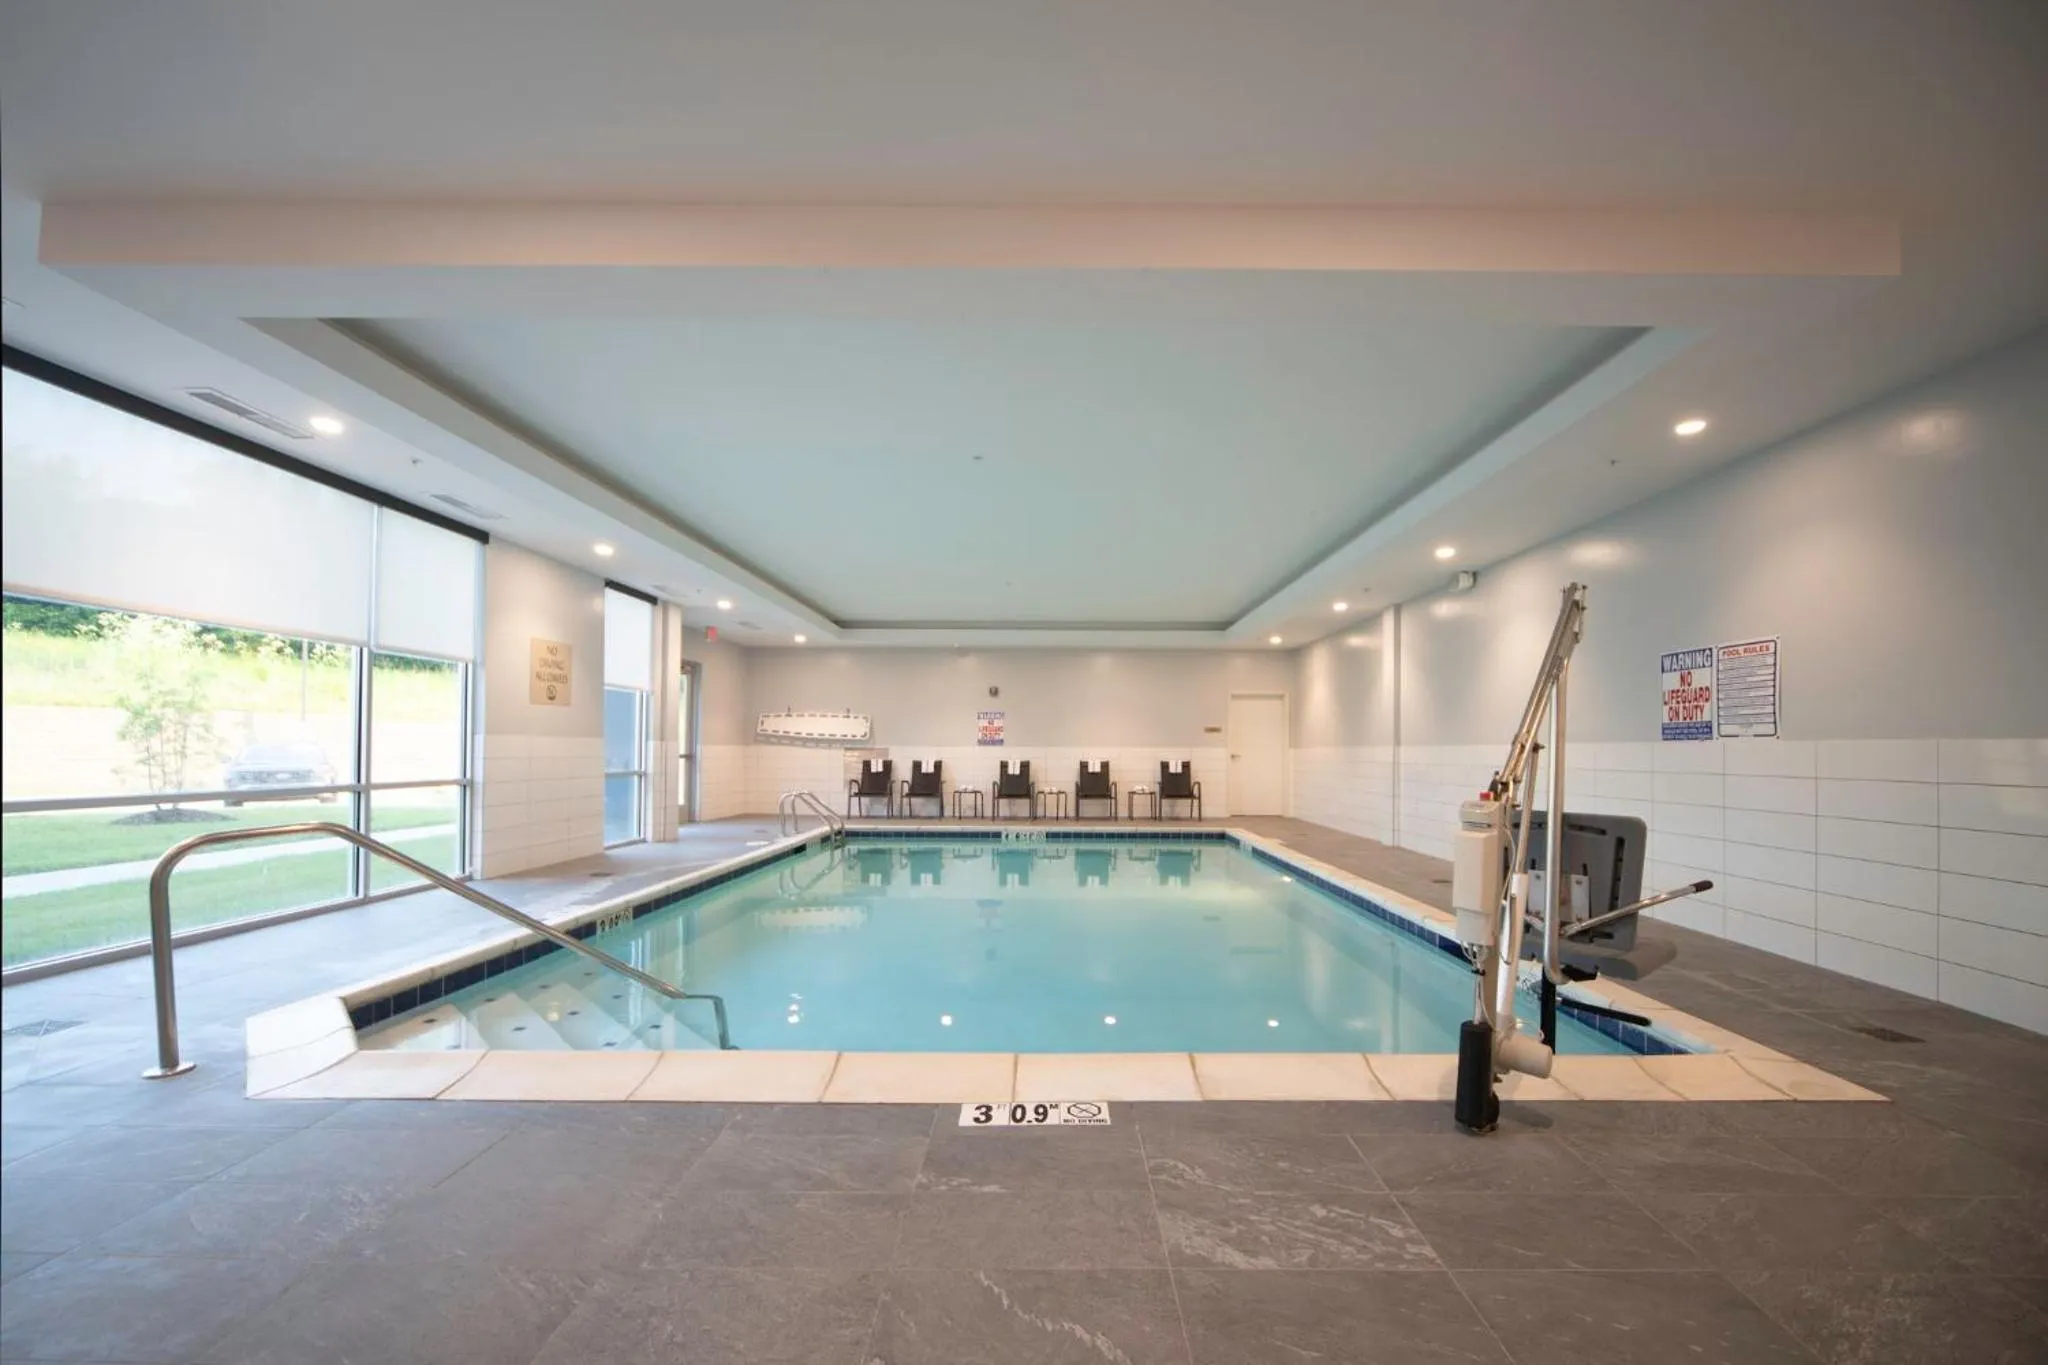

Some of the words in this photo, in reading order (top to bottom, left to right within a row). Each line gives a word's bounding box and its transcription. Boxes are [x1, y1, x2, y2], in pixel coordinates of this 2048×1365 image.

[1662, 649, 1712, 672] WARNING
[1723, 649, 1742, 659] POOL
[1743, 644, 1770, 656] RULES
[536, 671, 569, 684] ALLOWED
[1680, 670, 1693, 688] NO
[1663, 686, 1710, 706] LIFEGUARD
[1668, 706, 1680, 721] ON
[1683, 704, 1705, 721] DUTY
[973, 1104, 993, 1124] 3
[1011, 1103, 1049, 1124] 0.9
